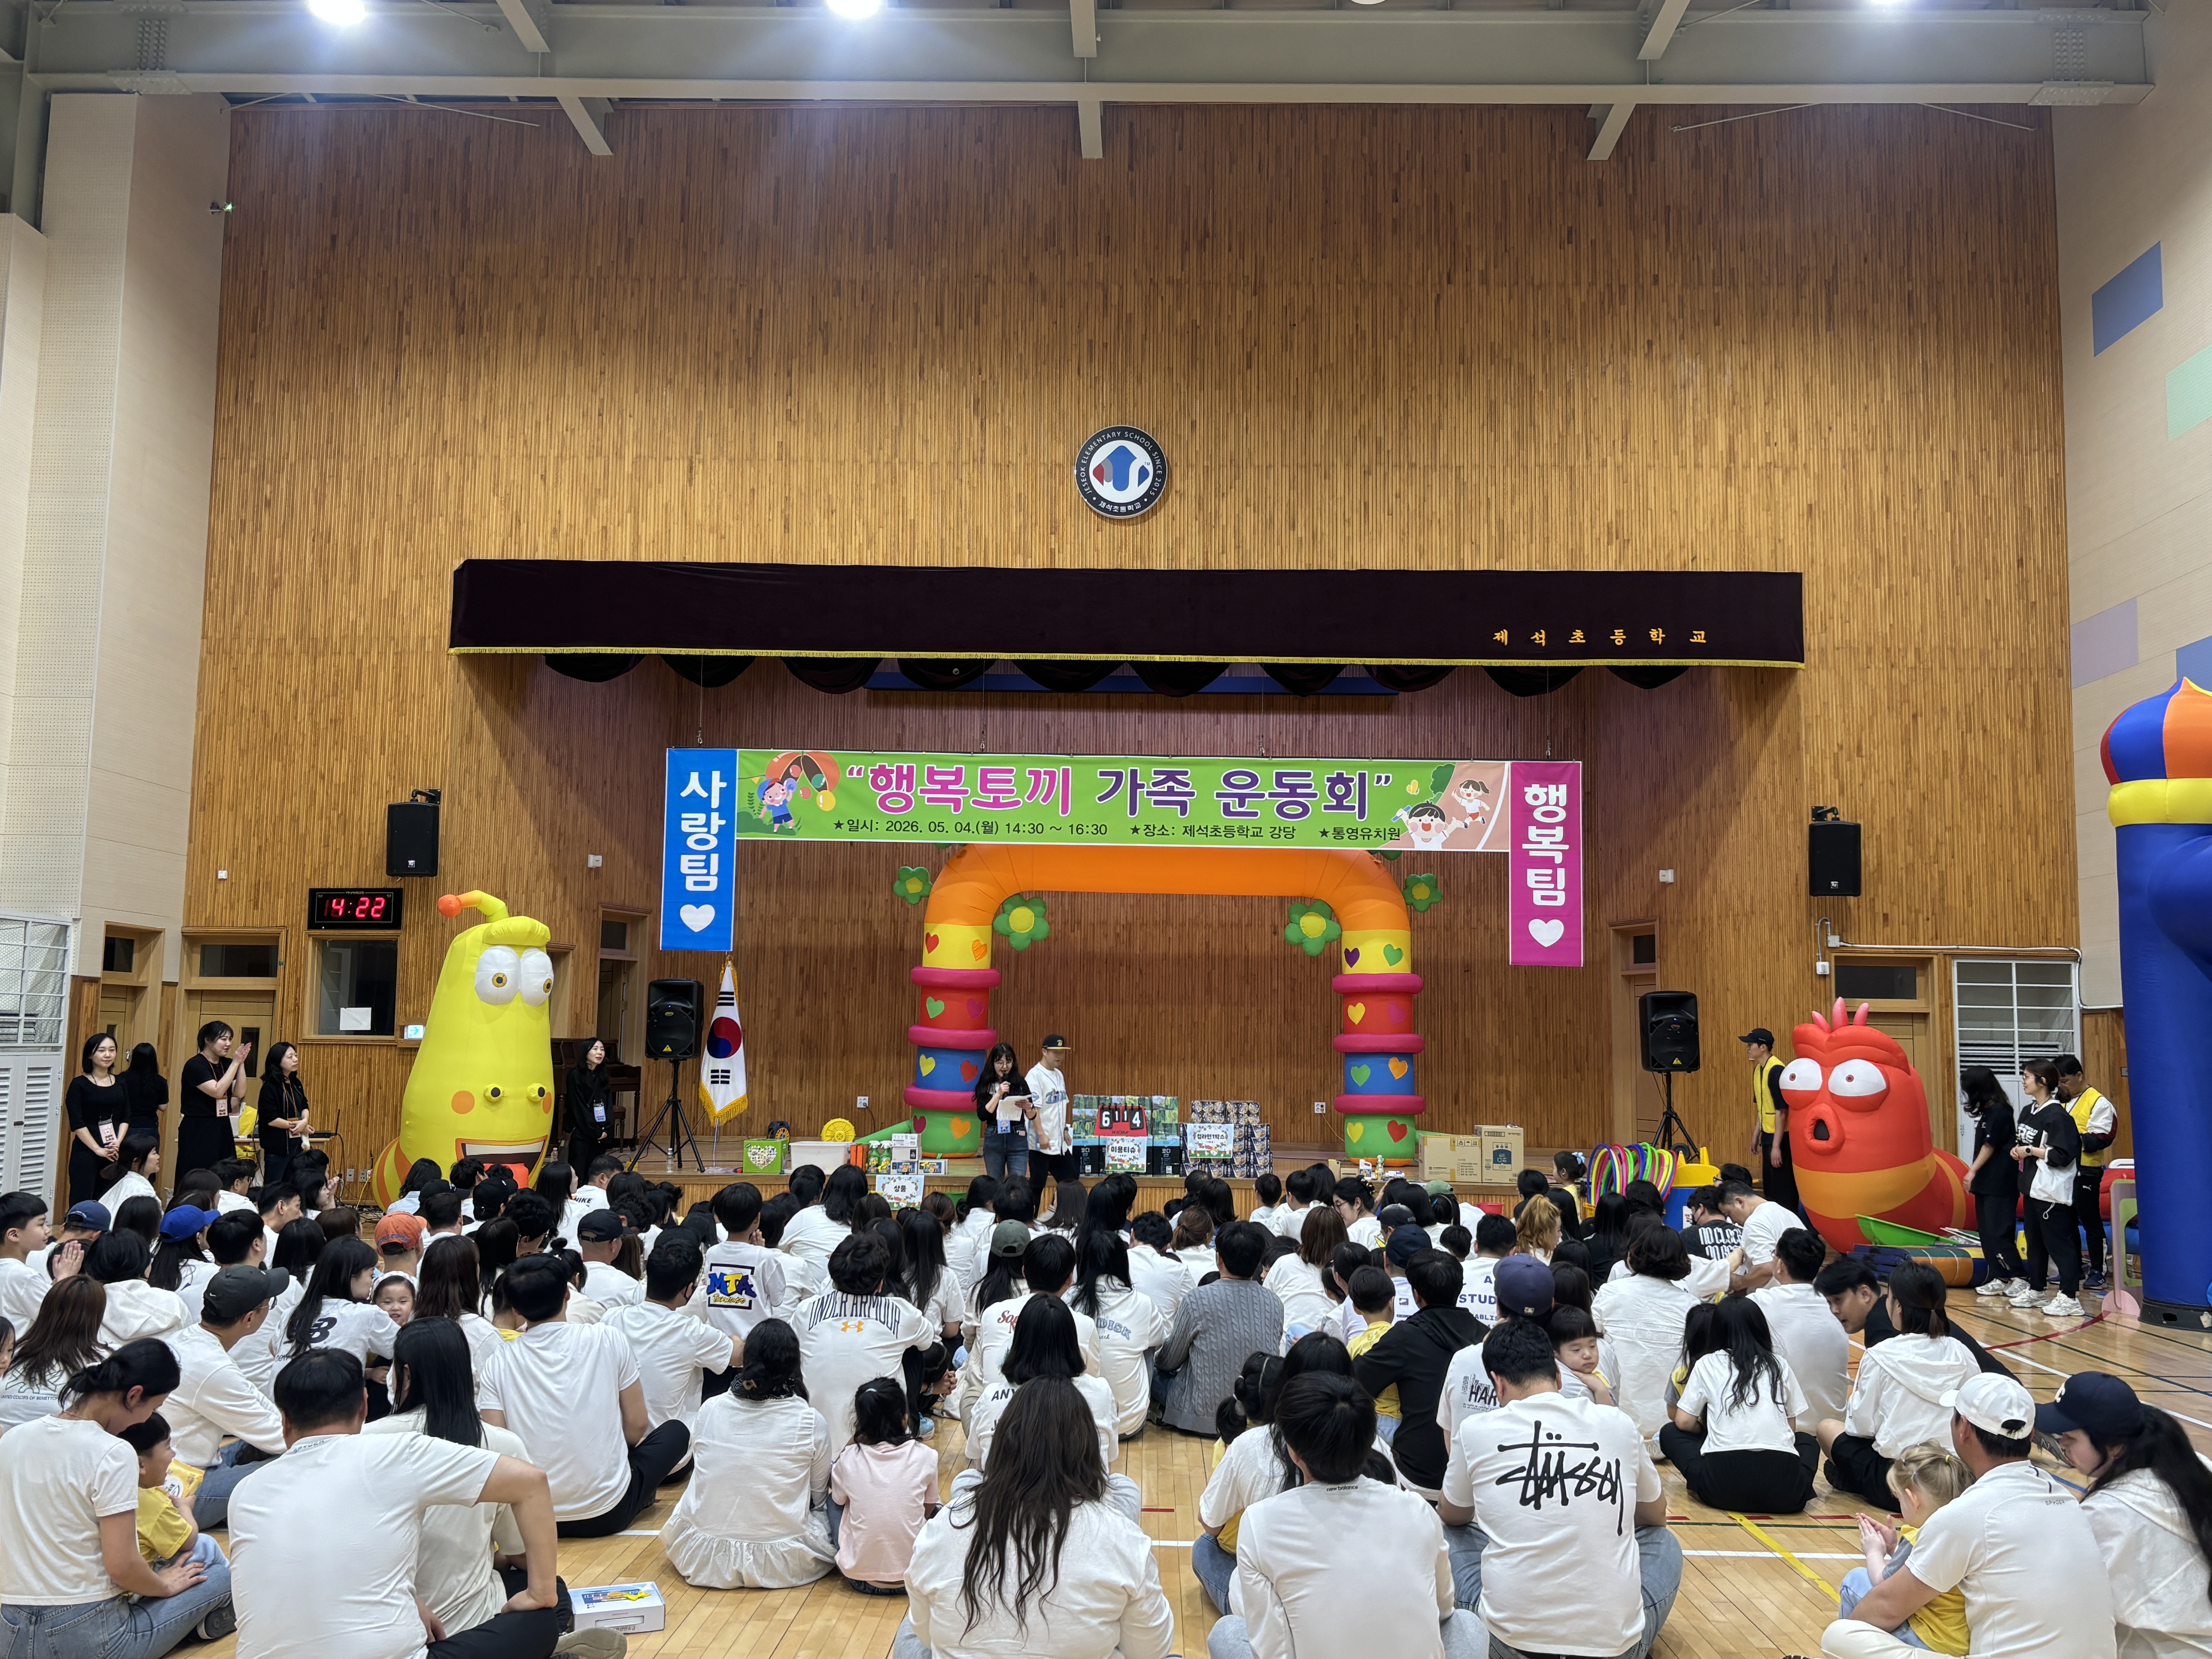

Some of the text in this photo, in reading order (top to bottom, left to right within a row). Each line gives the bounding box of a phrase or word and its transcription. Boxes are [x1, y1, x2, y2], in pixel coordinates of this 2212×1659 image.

[1082, 431, 1121, 464] ELEMENTARY
[1125, 431, 1152, 451] SCHOOL
[1152, 452, 1162, 474] SINCE
[1150, 478, 1161, 496] 2015
[1097, 768, 1196, 817] 가족
[680, 770, 727, 891] 사랑팀
[847, 819, 878, 832] 일시:
[886, 820, 922, 833] 2026.
[928, 821, 949, 833] 05.
[1005, 823, 1044, 834] 14:30
[1068, 823, 1108, 835] 16:30
[1143, 824, 1296, 840] 장소: 제석초등학교 강당
[1332, 826, 1401, 841] 통영유치원
[1522, 783, 1570, 907] 행복팀
[1102, 1111, 1110, 1127] 6
[1132, 1111, 1141, 1127] 4
[706, 1272, 757, 1298] MTA
[808, 1290, 901, 1340] UNDER ARMOUR
